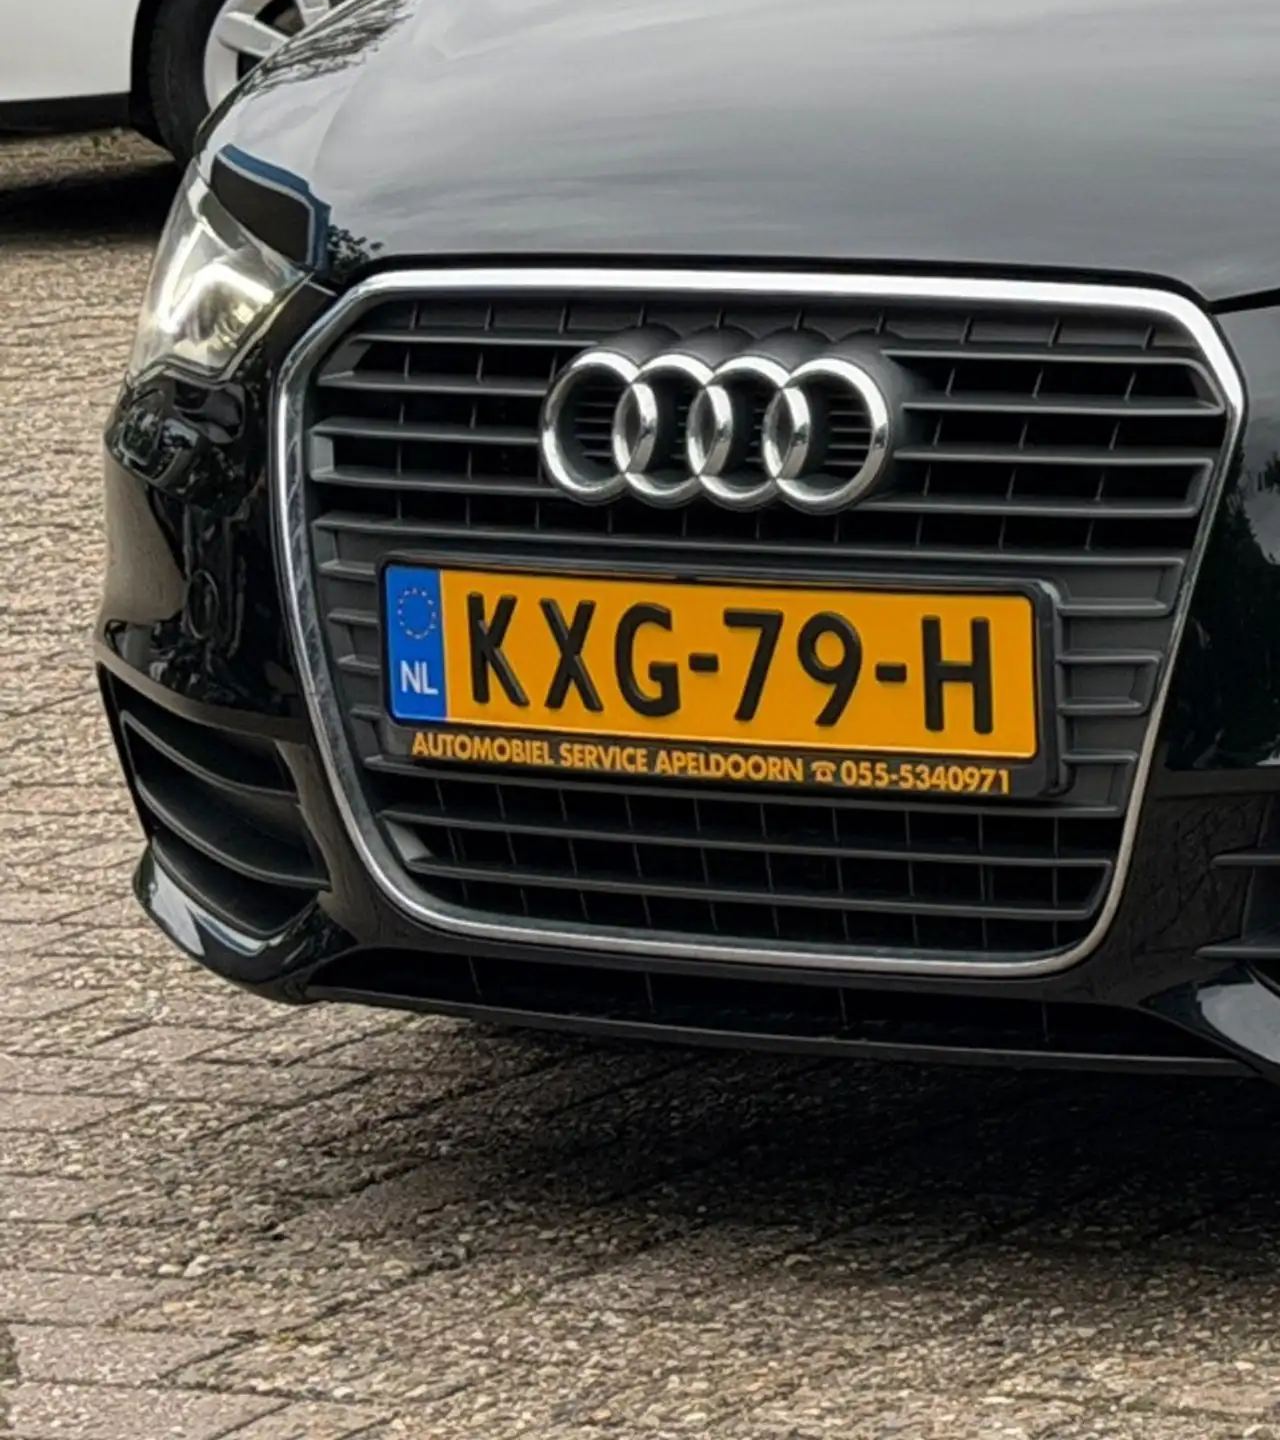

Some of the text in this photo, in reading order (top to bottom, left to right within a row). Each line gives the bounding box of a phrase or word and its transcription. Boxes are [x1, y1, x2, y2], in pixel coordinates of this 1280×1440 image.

[400, 662, 439, 696] NL
[465, 591, 995, 735] KXG-79-H
[411, 732, 1011, 795] AUTOMOBIEL SERVICE APELDOORN 055-5340971
